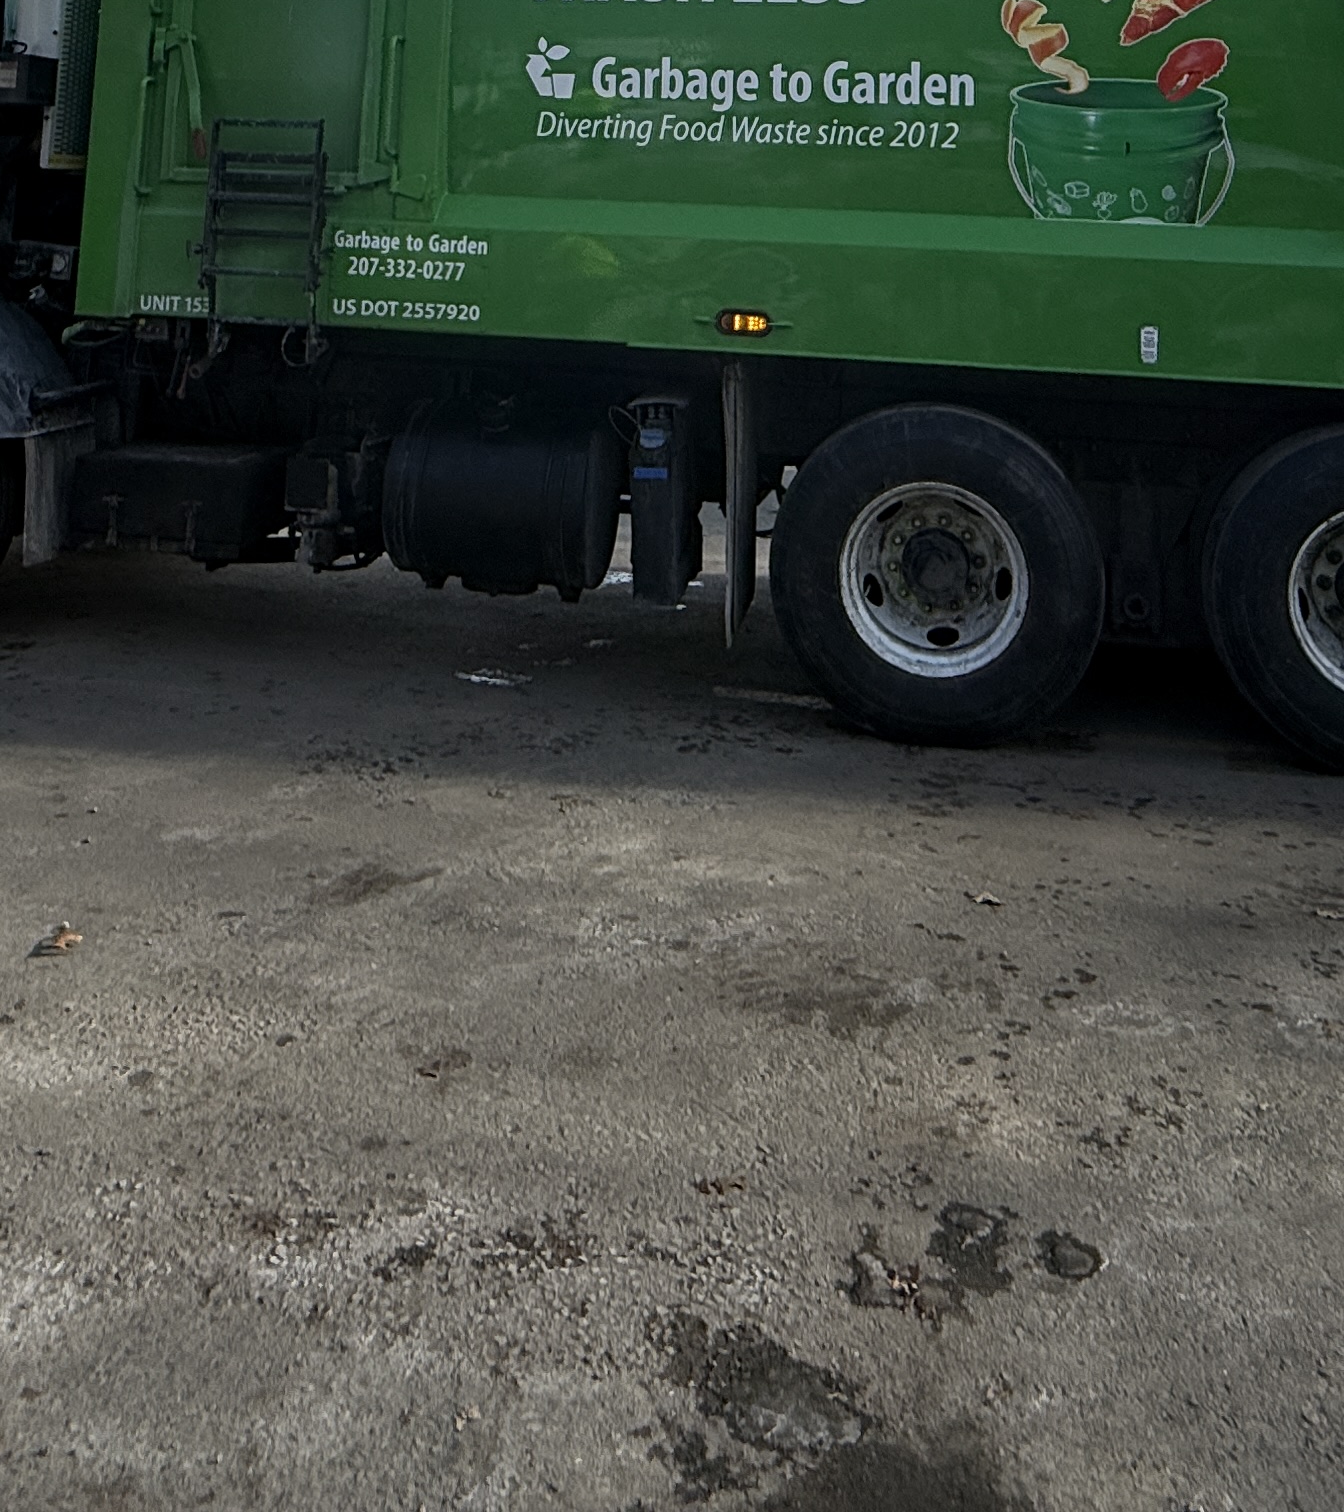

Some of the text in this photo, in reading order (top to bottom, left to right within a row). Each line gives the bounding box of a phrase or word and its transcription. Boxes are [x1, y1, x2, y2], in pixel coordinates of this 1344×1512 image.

[591, 56, 976, 113] Garbage to Garden
[536, 110, 960, 149] Diverting Food Waste since 2012
[333, 229, 489, 256] Garbage to Garden
[346, 255, 466, 282] 207-332-0277
[139, 294, 182, 312] UNIT
[331, 298, 481, 322] US DOT 2557920
